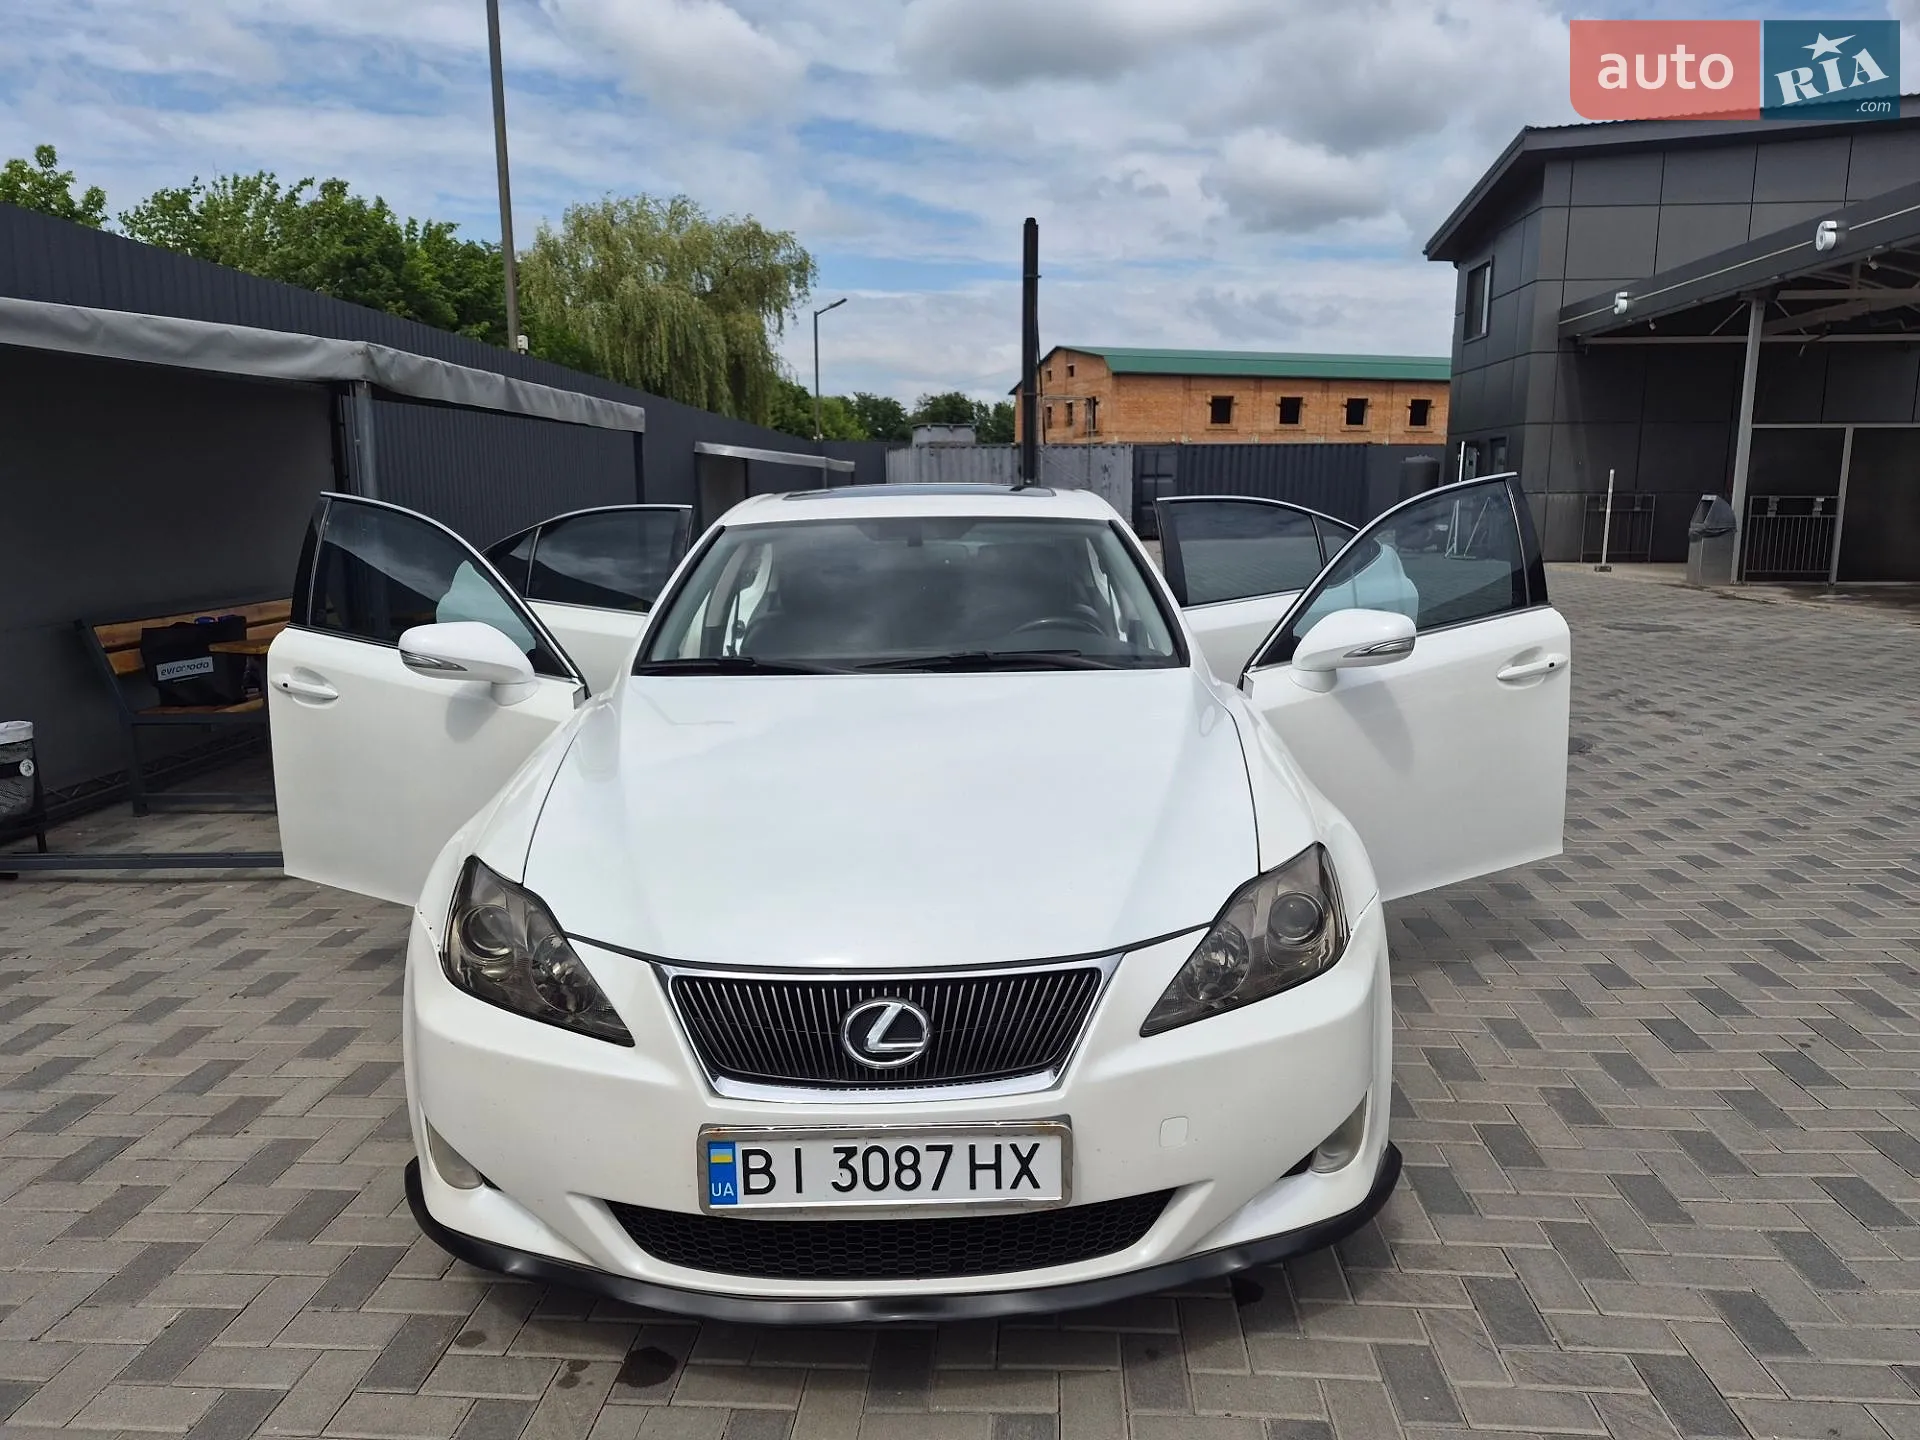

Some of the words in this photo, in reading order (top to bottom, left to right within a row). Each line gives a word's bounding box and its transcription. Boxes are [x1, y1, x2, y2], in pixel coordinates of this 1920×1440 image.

[831, 1144, 953, 1192] 3087
[968, 1142, 1041, 1190] HX
[711, 1182, 734, 1197] UA
